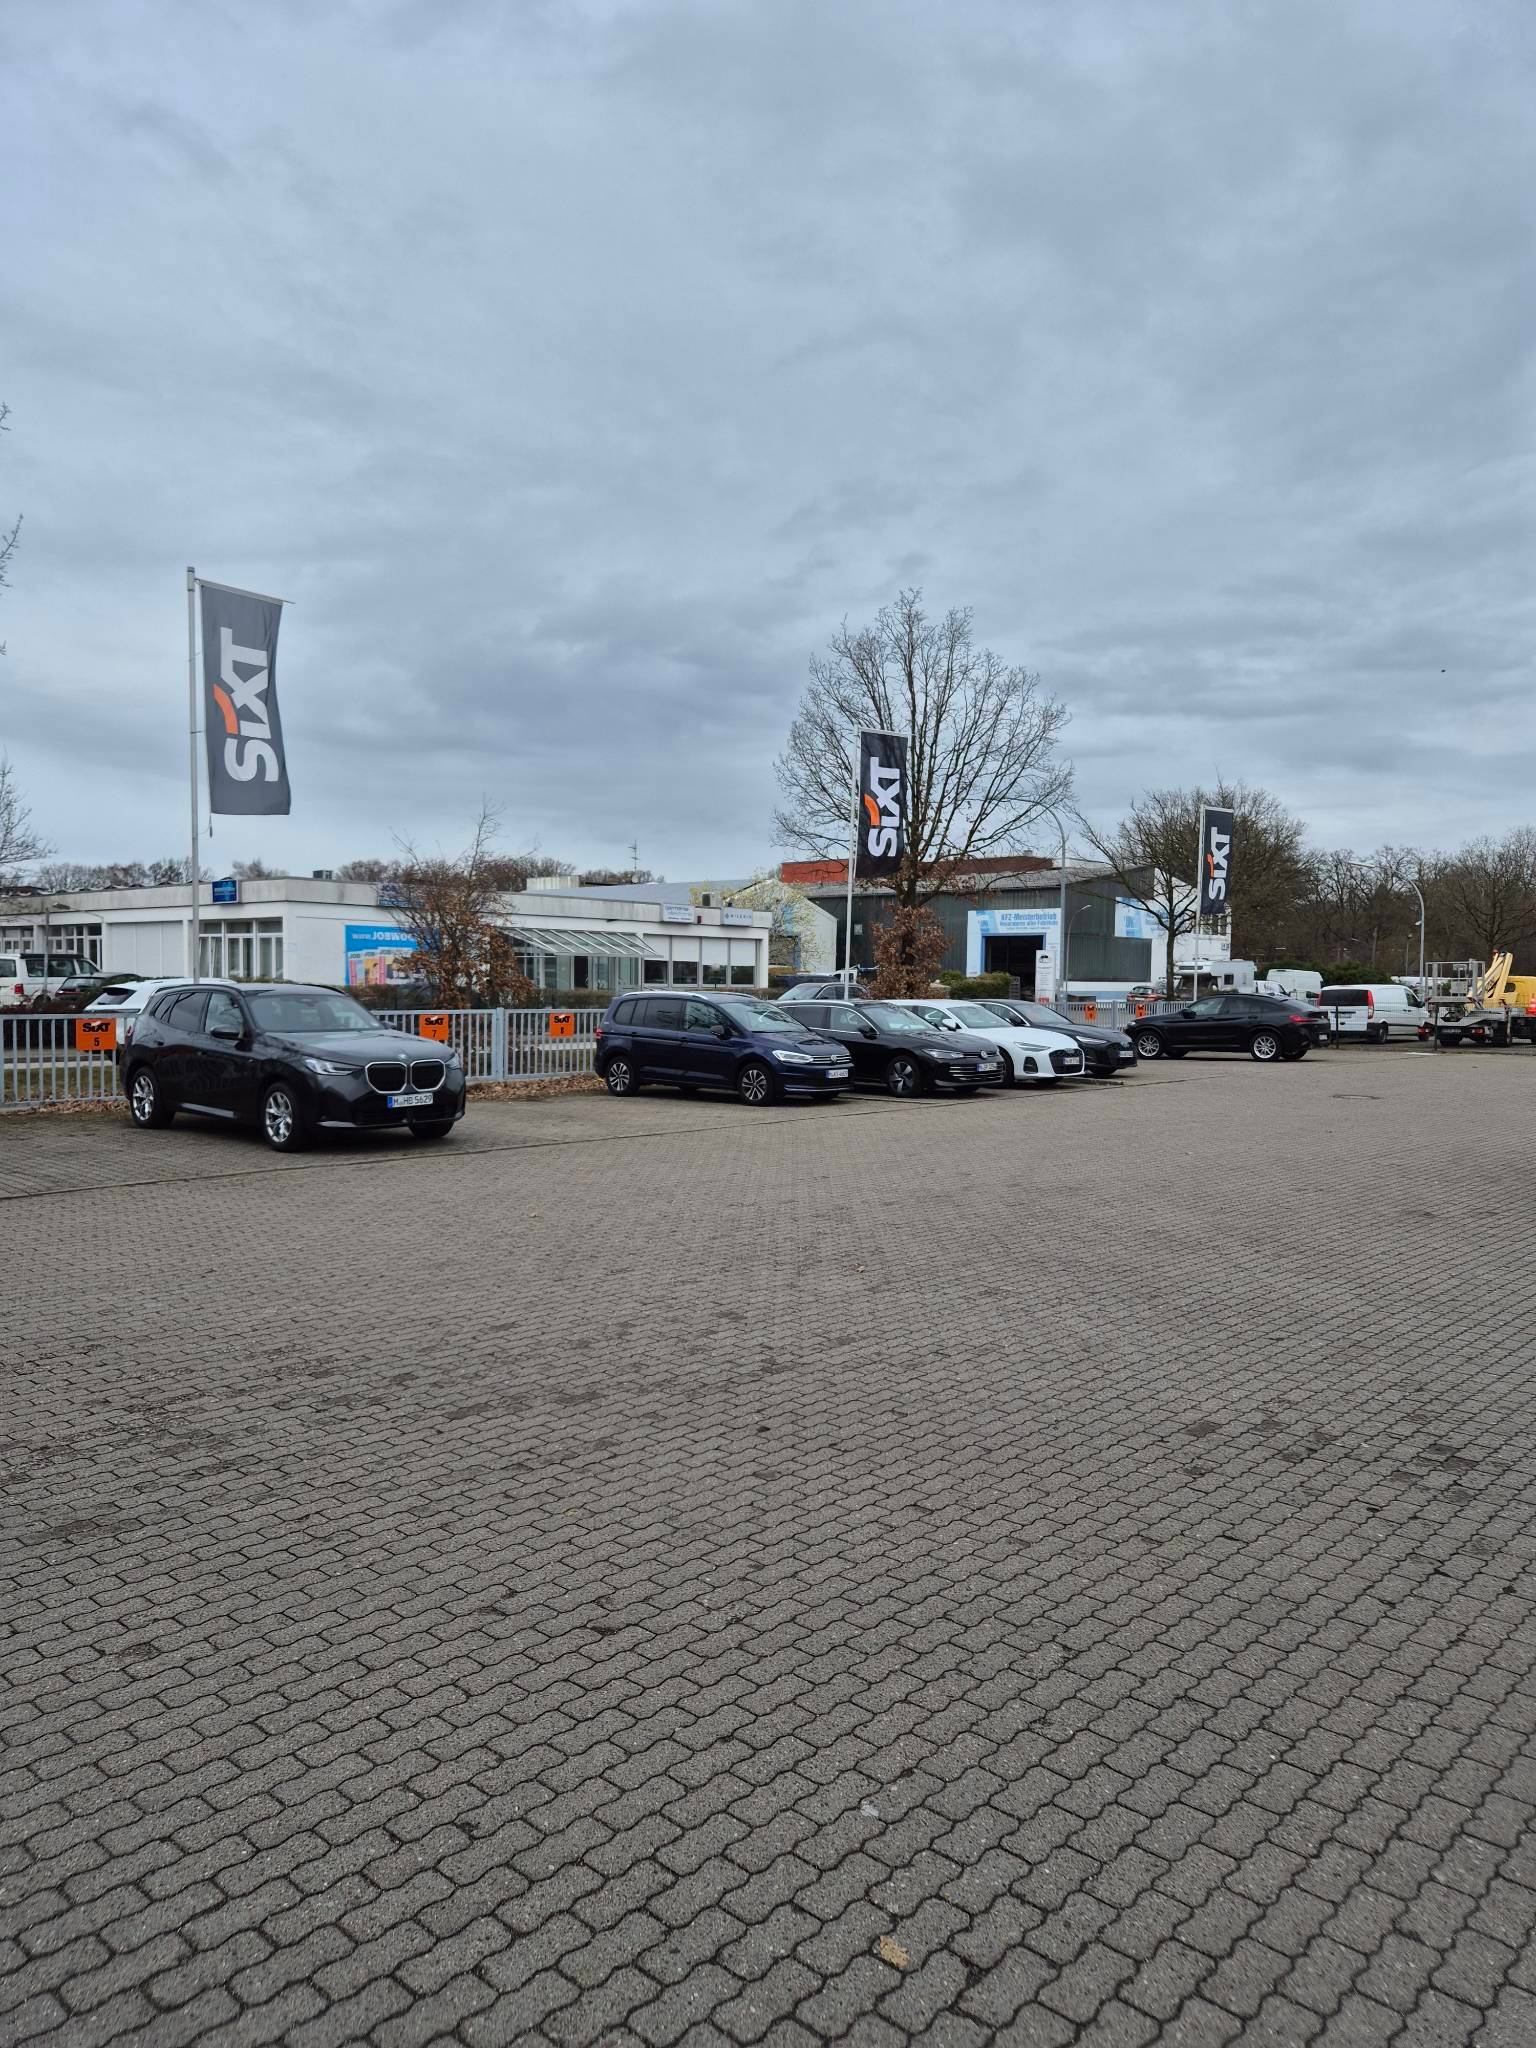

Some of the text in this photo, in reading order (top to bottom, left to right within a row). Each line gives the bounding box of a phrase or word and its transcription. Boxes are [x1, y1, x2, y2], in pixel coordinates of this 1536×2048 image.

[213, 626, 279, 781] SIXT
[864, 756, 900, 857] SIXT
[1207, 826, 1230, 900] SIXT
[94, 1037, 100, 1047] 5
[432, 1029, 438, 1037] 7
